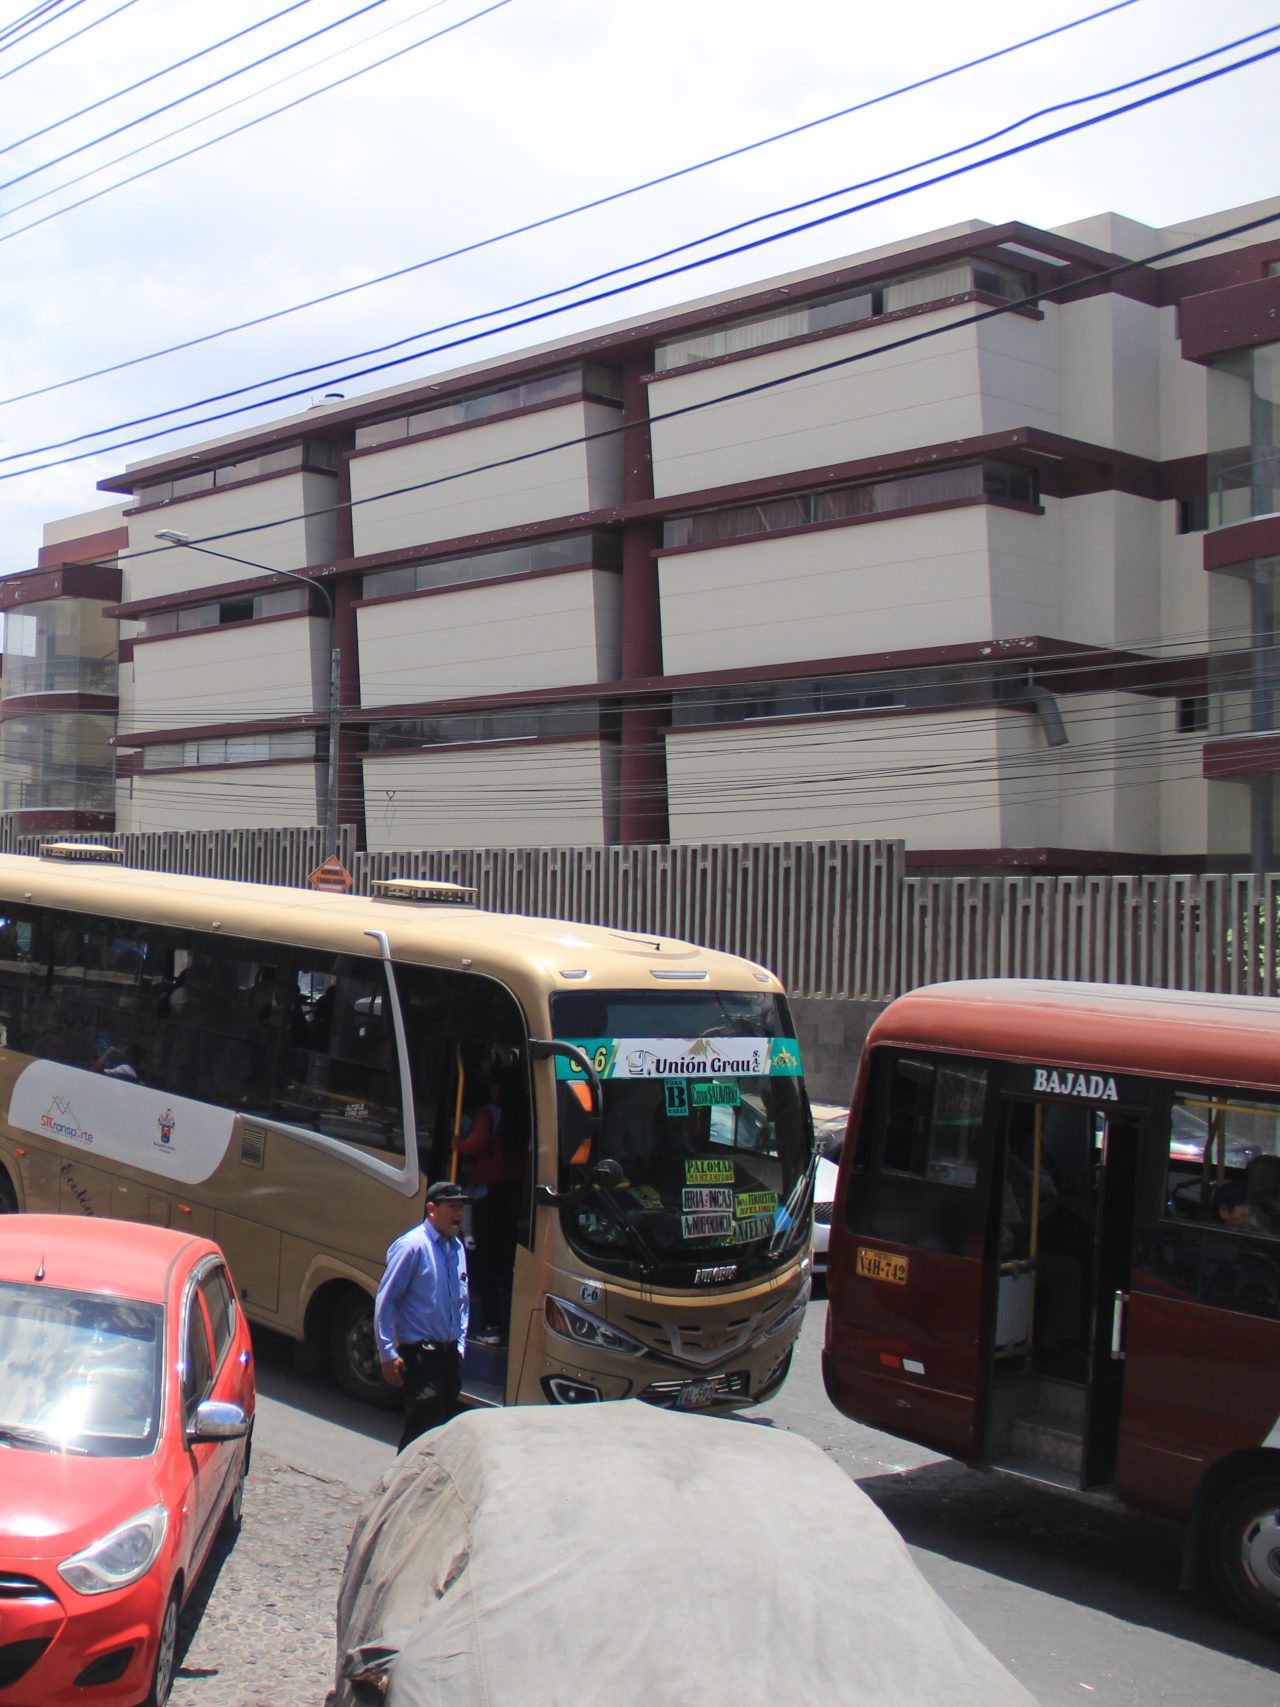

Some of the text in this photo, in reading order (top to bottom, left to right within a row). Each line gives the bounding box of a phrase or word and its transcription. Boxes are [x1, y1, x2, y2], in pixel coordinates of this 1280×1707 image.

[655, 1056, 707, 1074] Unión
[710, 1057, 750, 1073] Grau
[1033, 1069, 1118, 1101] BAJADA
[666, 1086, 687, 1108] B
[687, 1161, 733, 1174] PALOMAR
[860, 1257, 906, 1281] V4H-742
